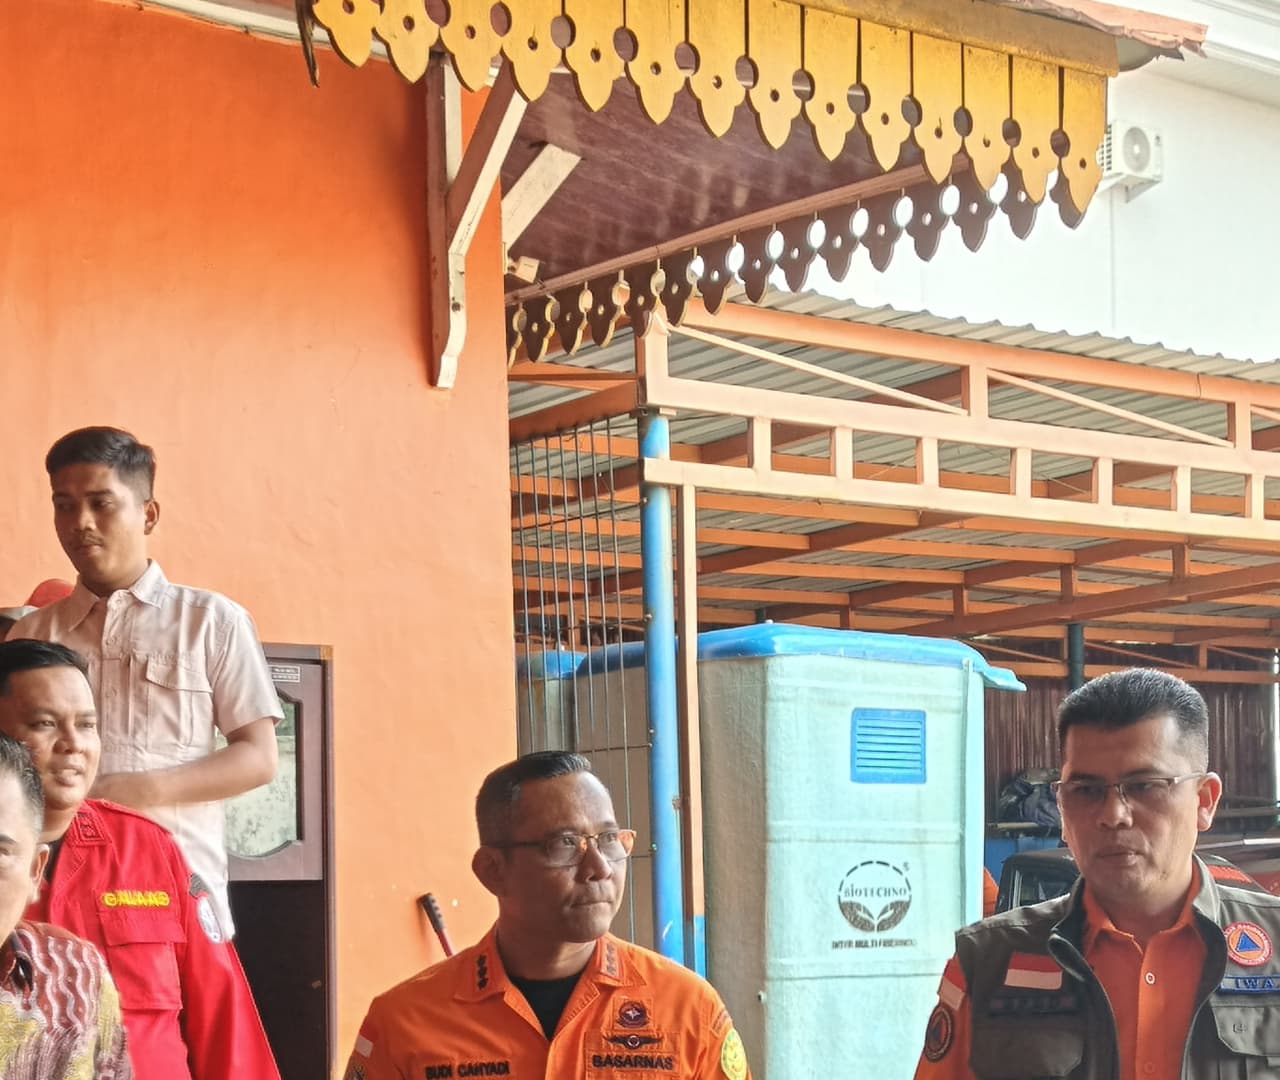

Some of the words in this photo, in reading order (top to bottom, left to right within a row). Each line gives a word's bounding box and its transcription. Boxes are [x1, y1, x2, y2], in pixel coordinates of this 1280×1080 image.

[425, 1064, 453, 1080] BUDI
[458, 1061, 511, 1077] CAHYADI
[592, 1054, 673, 1071] BASARNAS
